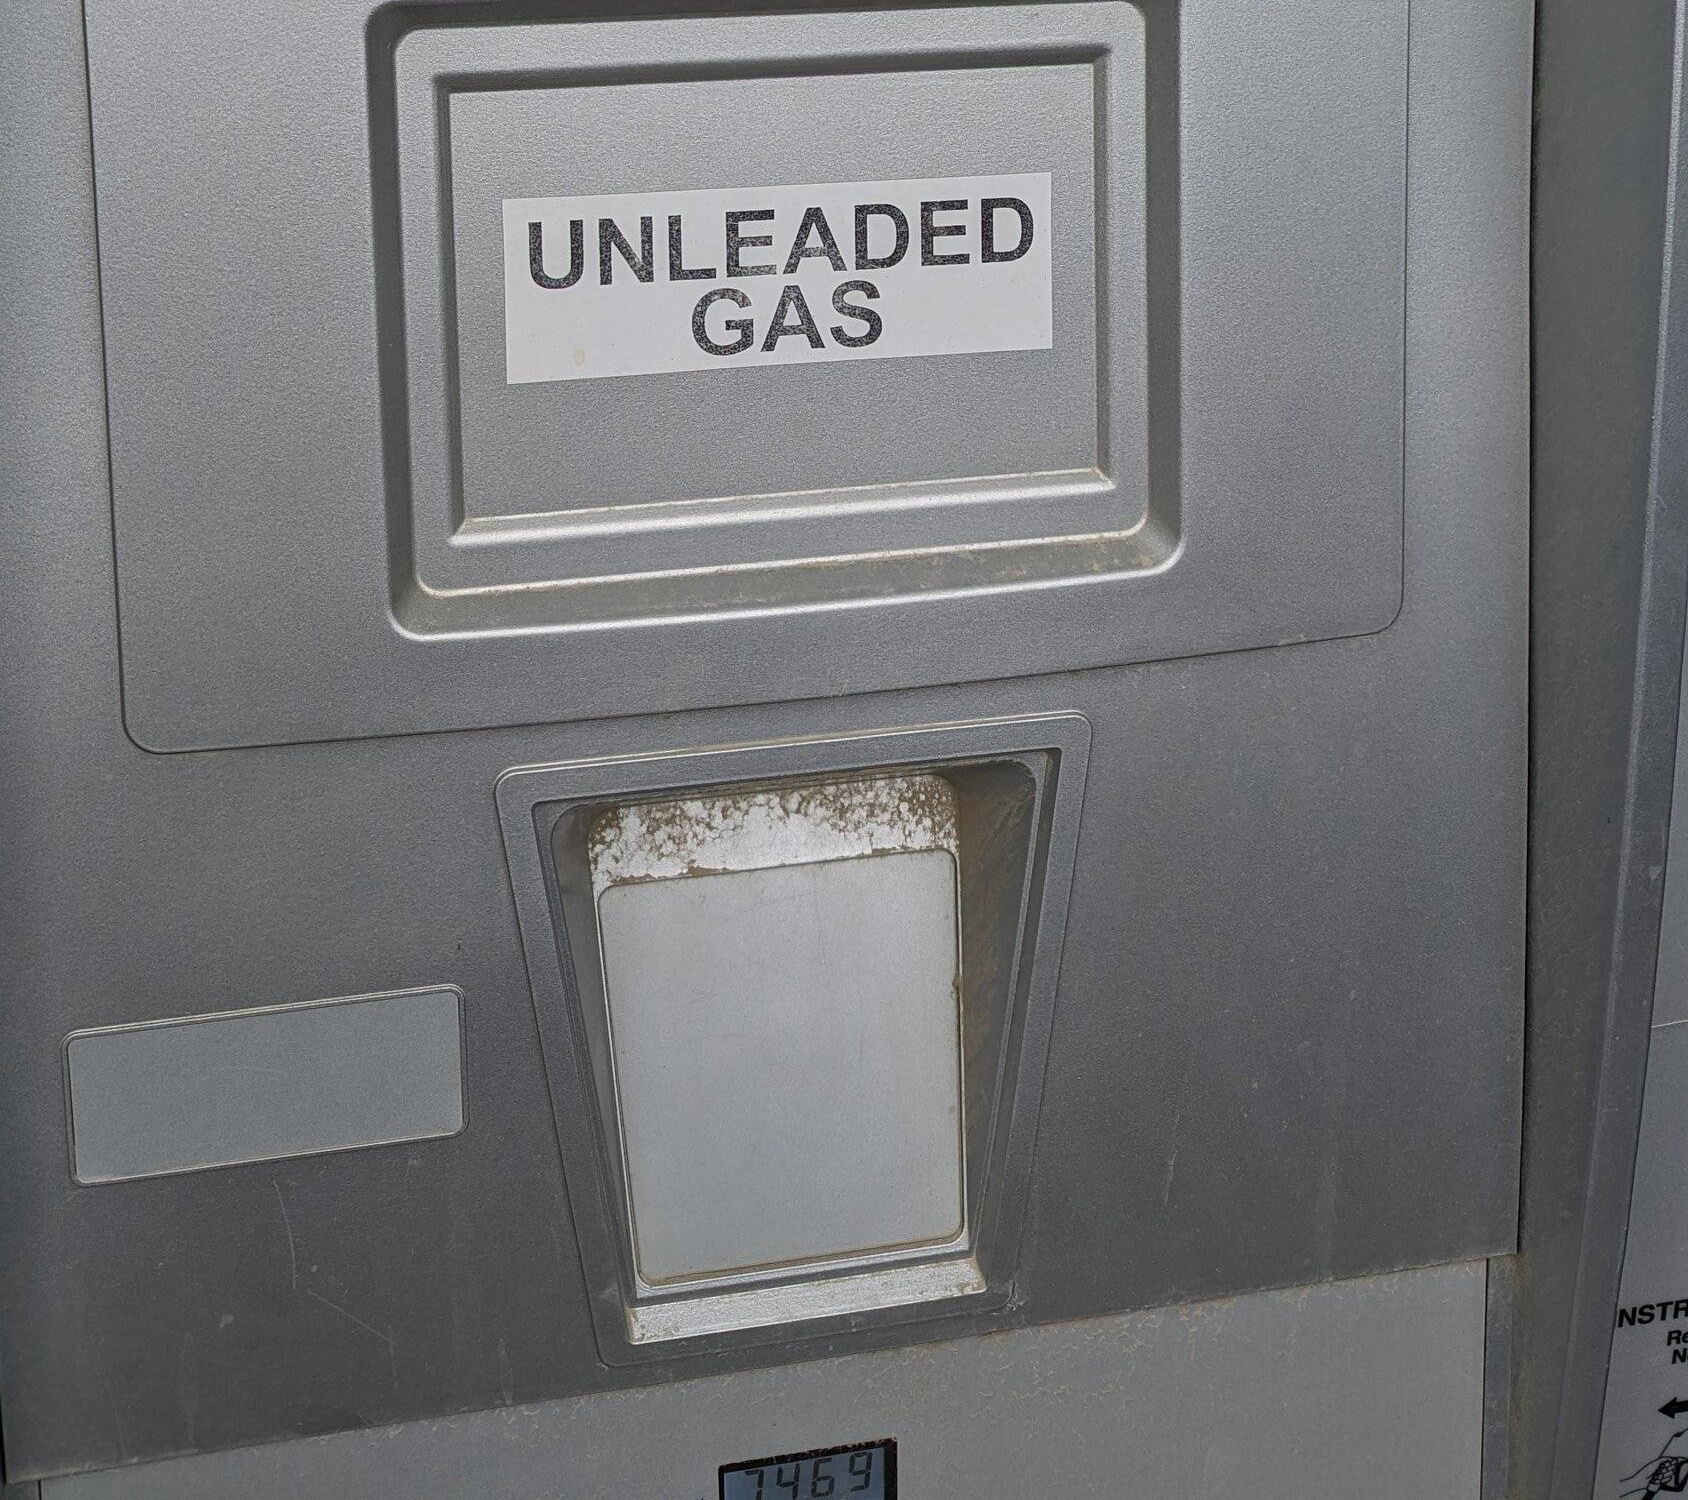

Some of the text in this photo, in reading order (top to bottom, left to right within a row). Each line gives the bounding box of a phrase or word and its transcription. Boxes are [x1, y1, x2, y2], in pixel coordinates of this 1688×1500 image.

[528, 197, 1035, 289] UNLEADED
[691, 279, 883, 356] GAS
[745, 1451, 873, 1500] 7469
